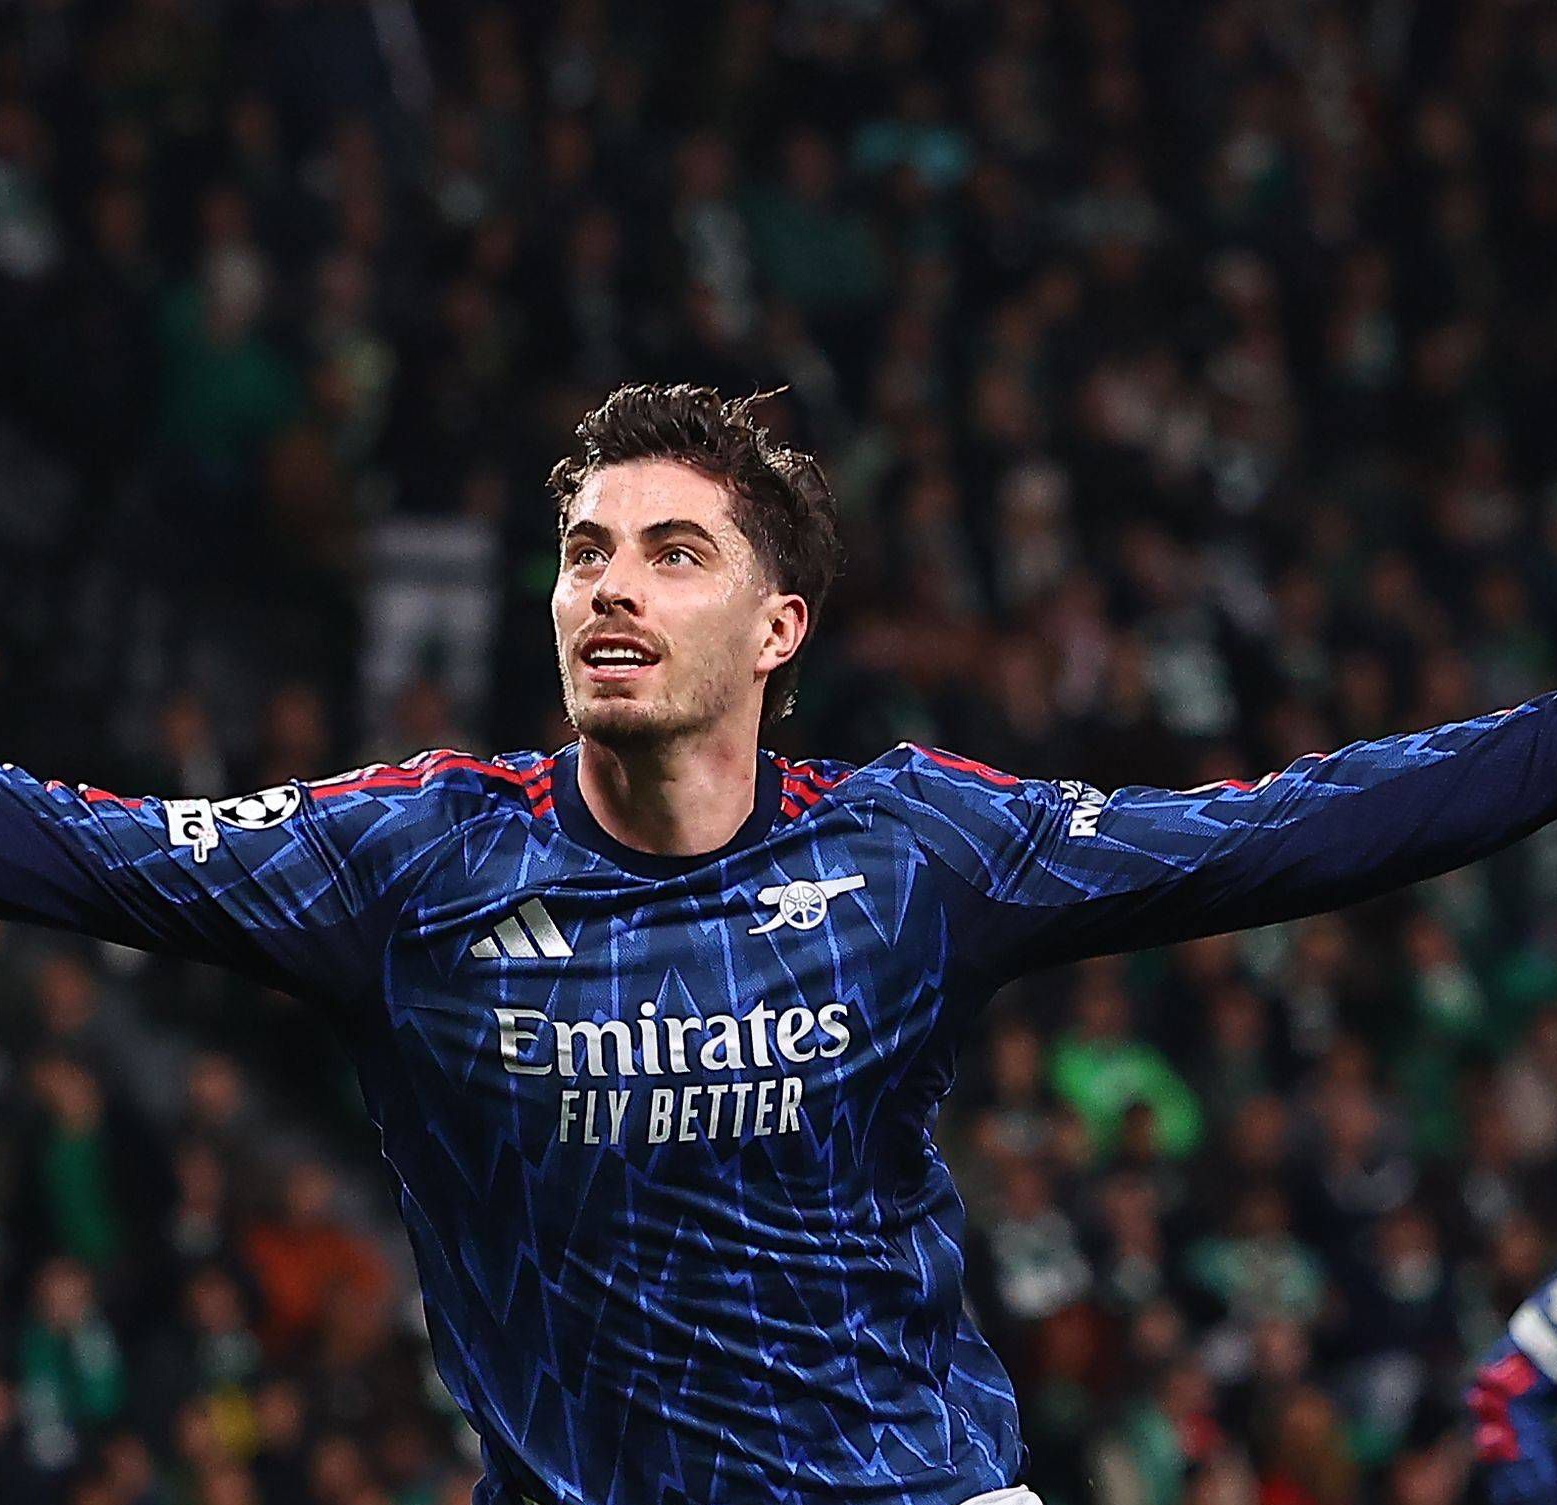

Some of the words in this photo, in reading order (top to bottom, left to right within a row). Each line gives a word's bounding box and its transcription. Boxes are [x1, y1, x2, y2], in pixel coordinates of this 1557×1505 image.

[493, 999, 852, 1077] Emirates
[559, 1089, 632, 1146] FLY
[647, 1076, 805, 1145] BETTER
